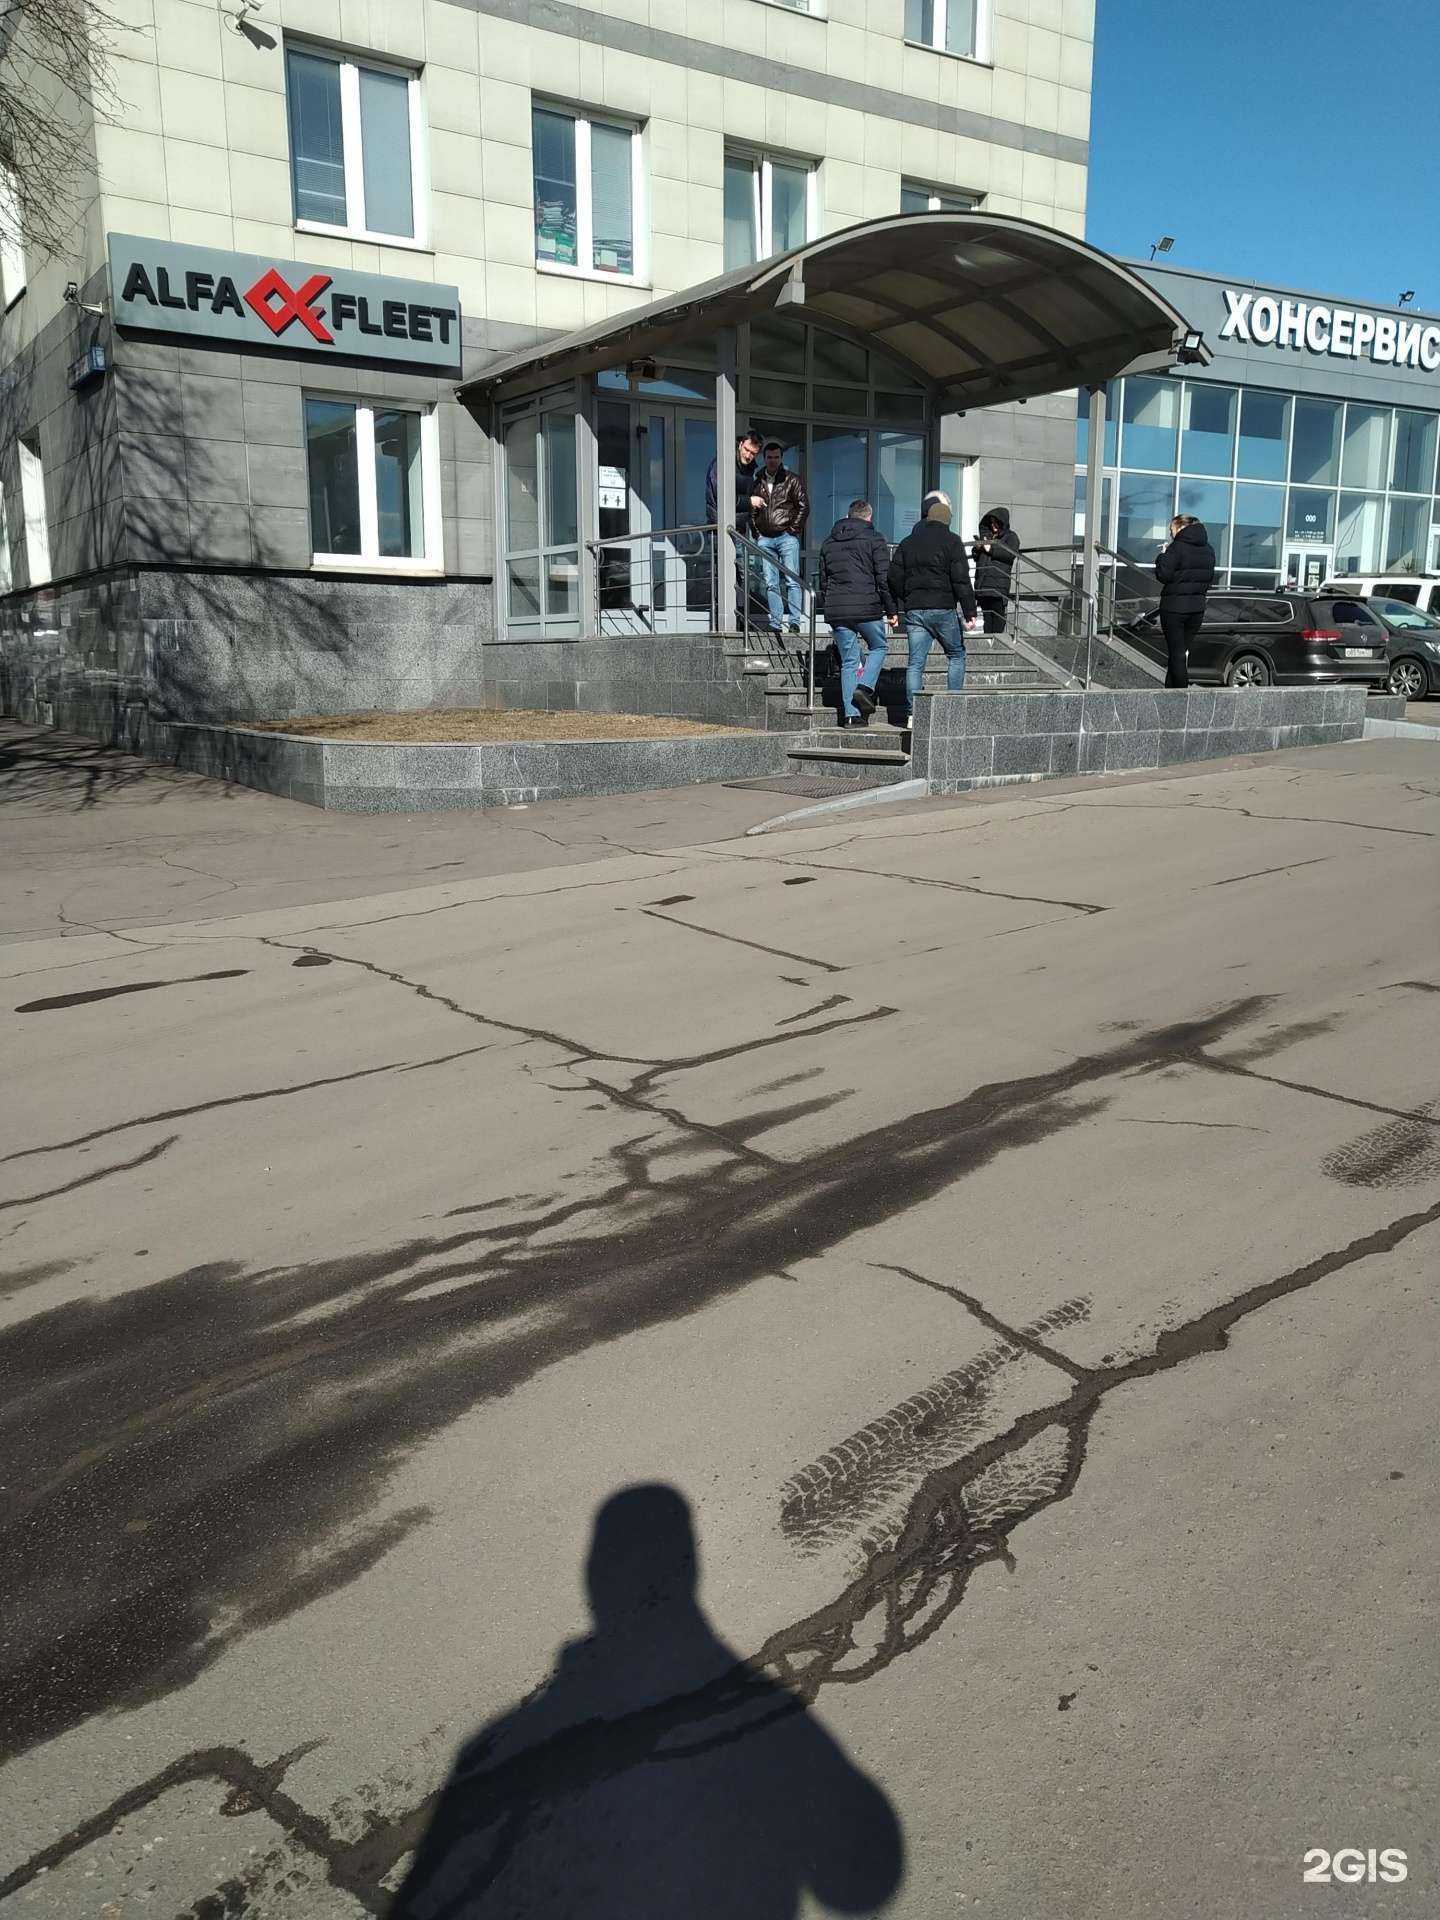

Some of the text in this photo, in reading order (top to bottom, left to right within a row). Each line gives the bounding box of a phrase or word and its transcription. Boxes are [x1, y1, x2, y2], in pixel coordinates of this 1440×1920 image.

[121, 261, 457, 344] ALFA FLEET
[1219, 290, 1440, 371] ХОНСЕРВИС
